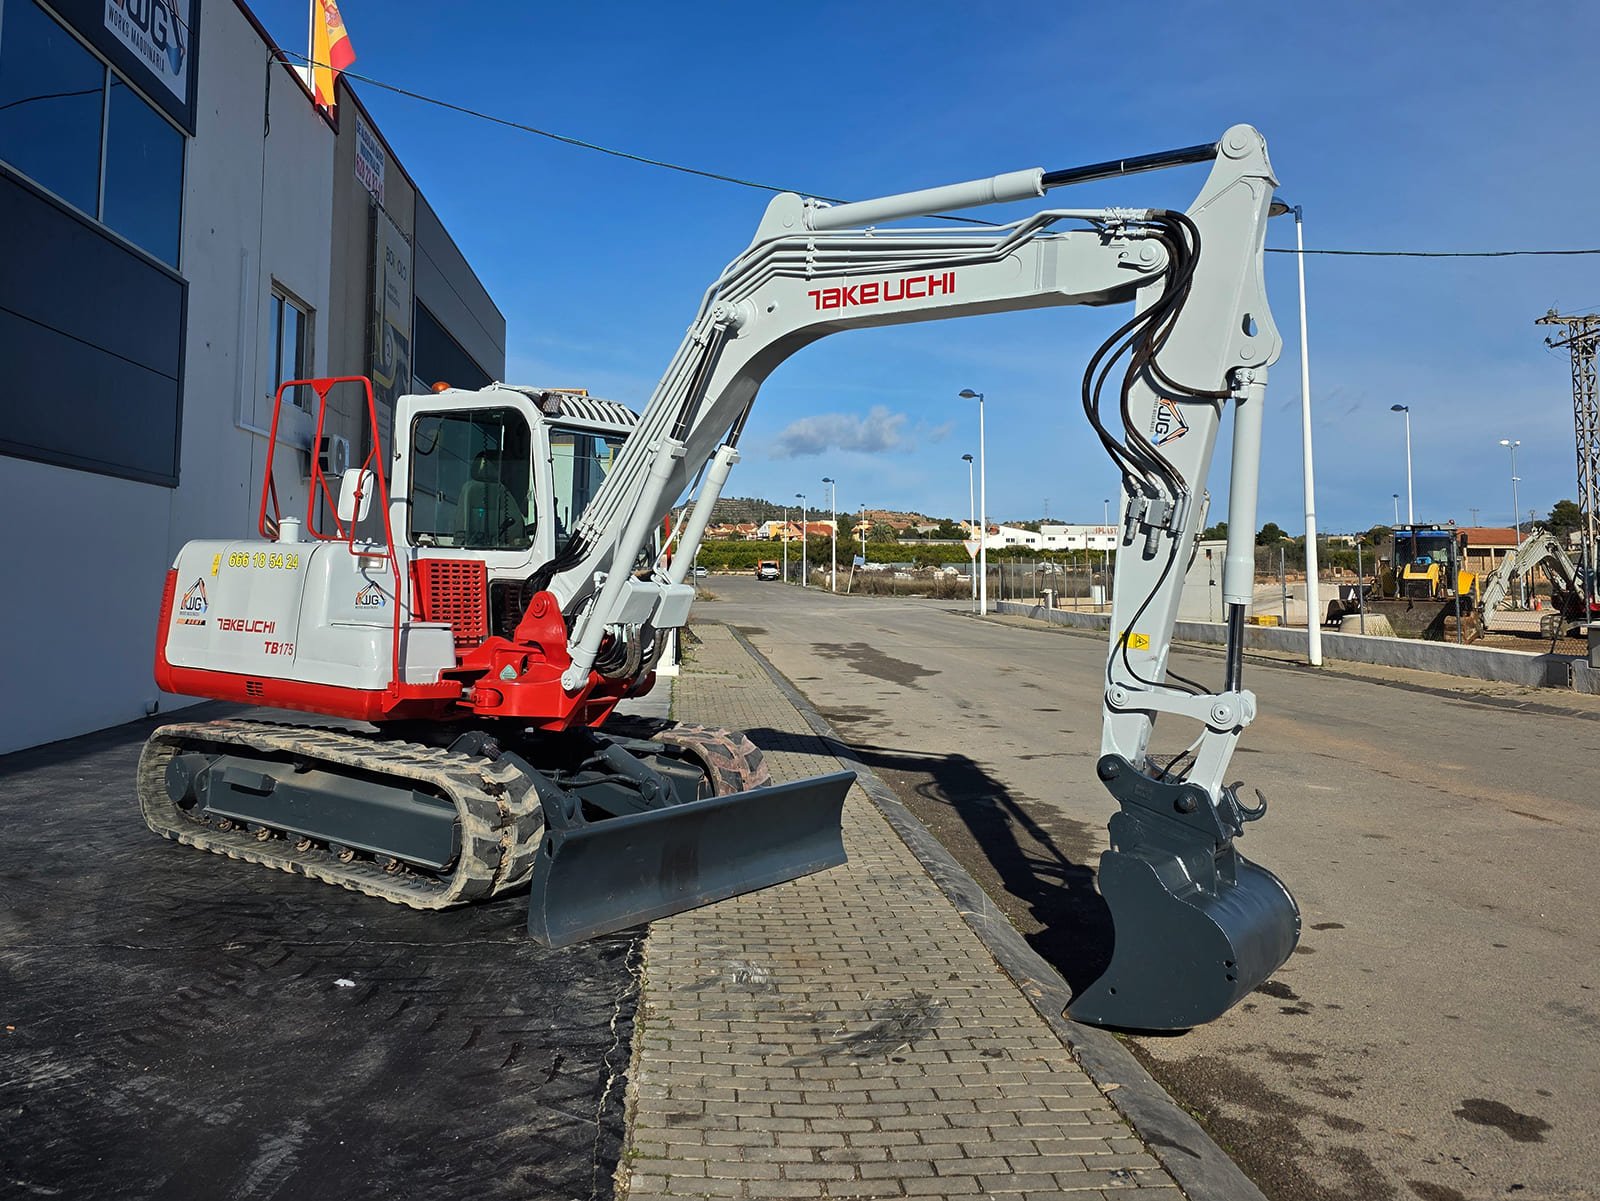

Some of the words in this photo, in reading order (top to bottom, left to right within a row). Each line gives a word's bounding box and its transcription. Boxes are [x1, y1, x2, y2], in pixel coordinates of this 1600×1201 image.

[108, 3, 130, 39] WORKS
[130, 26, 165, 74] MAQUINARIA
[228, 552, 250, 568] 666
[252, 552, 267, 569] 18
[269, 553, 283, 569] 54
[285, 553, 299, 570] 24
[264, 641, 294, 656] TB175
